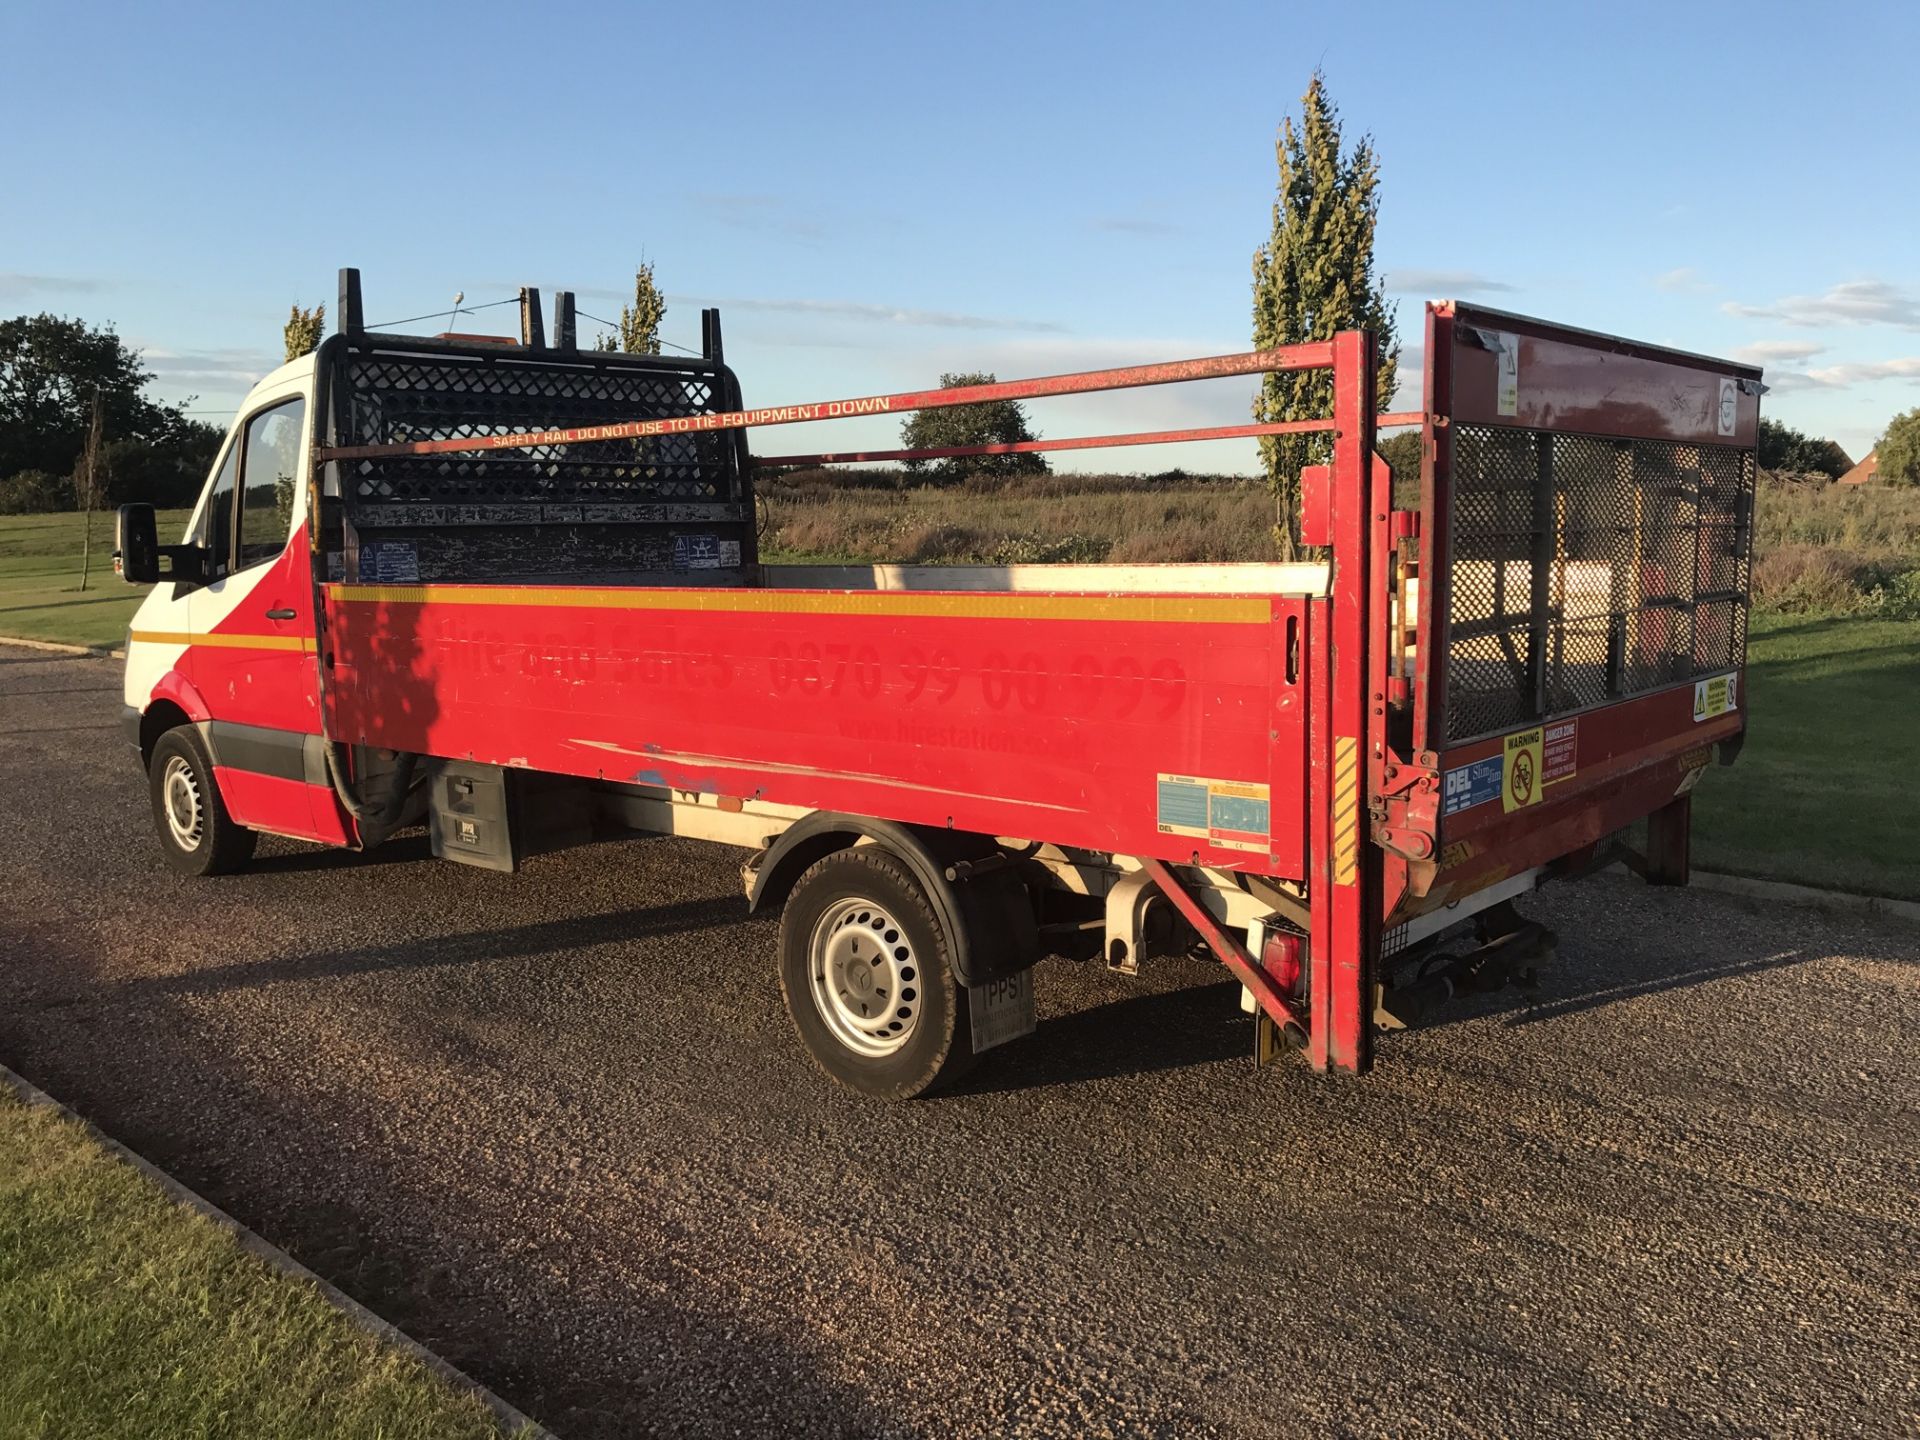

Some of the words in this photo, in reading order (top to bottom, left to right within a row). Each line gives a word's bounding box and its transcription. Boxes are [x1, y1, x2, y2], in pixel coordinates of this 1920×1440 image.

[493, 433, 539, 447] SAFETY
[544, 430, 574, 443] RAIL
[577, 428, 597, 441] DO
[602, 425, 630, 438] NOT
[635, 422, 664, 435] USE
[671, 419, 689, 432] TO
[694, 416, 717, 429] TIE
[722, 404, 822, 427] EQUIPMENT
[829, 397, 890, 416] DOWN
[520, 621, 596, 683] and
[612, 624, 735, 690] Sales
[767, 639, 883, 702] 0870
[897, 645, 961, 705] 99
[979, 647, 1048, 713] 00
[1508, 731, 1540, 750] WARNING
[1446, 767, 1472, 796] DEL
[1473, 763, 1489, 780] Slim
[1487, 768, 1502, 784] Jim
[988, 976, 1017, 1007] PPS
